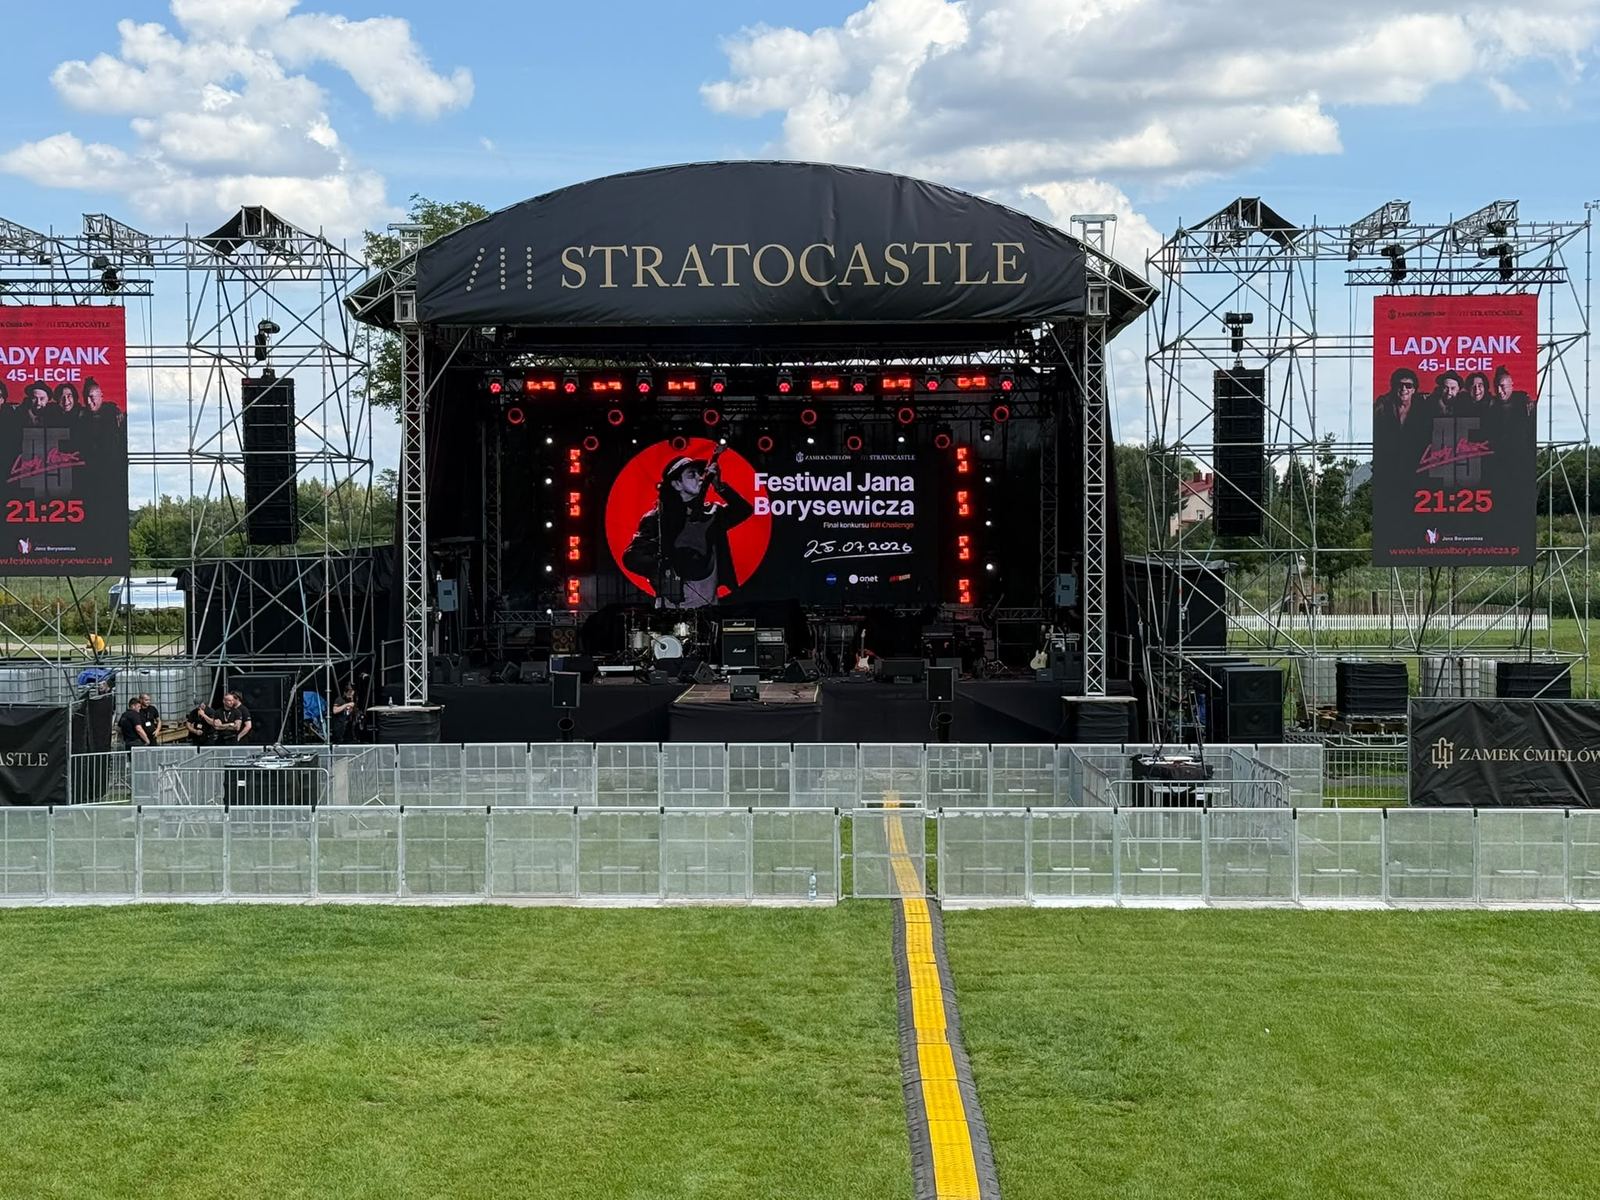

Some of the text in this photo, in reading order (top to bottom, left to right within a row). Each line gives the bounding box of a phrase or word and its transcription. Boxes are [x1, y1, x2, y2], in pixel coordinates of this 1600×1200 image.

[560, 241, 1028, 290] STRATOCASTLE
[1390, 335, 1521, 355] LADY PANK
[45, 346, 110, 365] PANK
[1418, 357, 1493, 371] 45-LECIE
[6, 368, 81, 382] 45-LECIE
[754, 472, 915, 492] Festiwal Jana
[6, 501, 85, 522] 21:25
[754, 496, 915, 521] Borysewicza
[1414, 490, 1493, 513] 21:25
[804, 540, 912, 558] 25.07.2026
[1459, 746, 1600, 762] ZAMEK ĆMIELÓW
